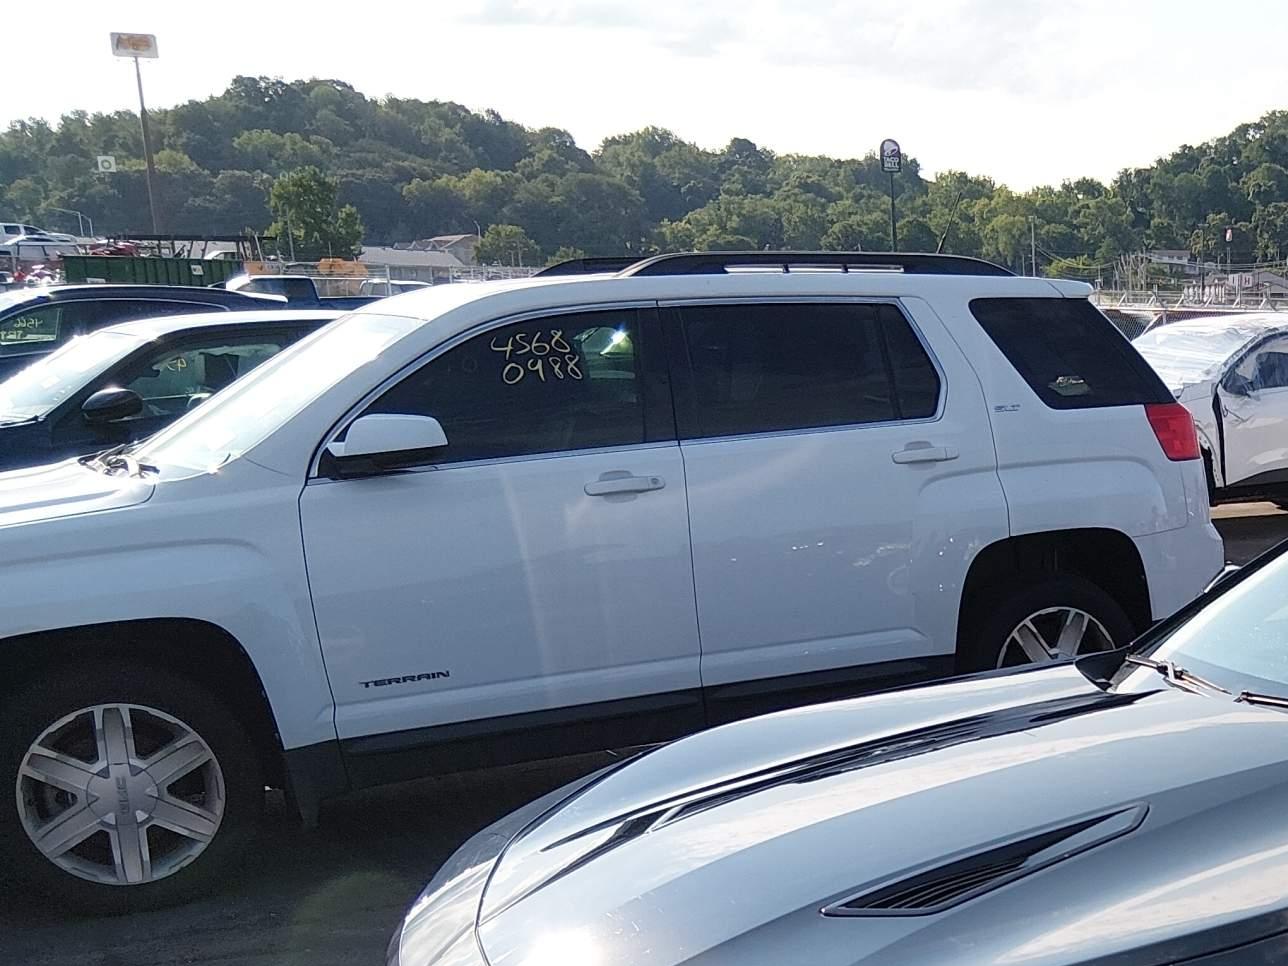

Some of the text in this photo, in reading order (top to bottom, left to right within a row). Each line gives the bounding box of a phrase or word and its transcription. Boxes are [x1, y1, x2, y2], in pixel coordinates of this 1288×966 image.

[490, 329, 571, 360] 4568
[502, 354, 583, 384] 0988
[359, 670, 450, 688] TERRAIN
